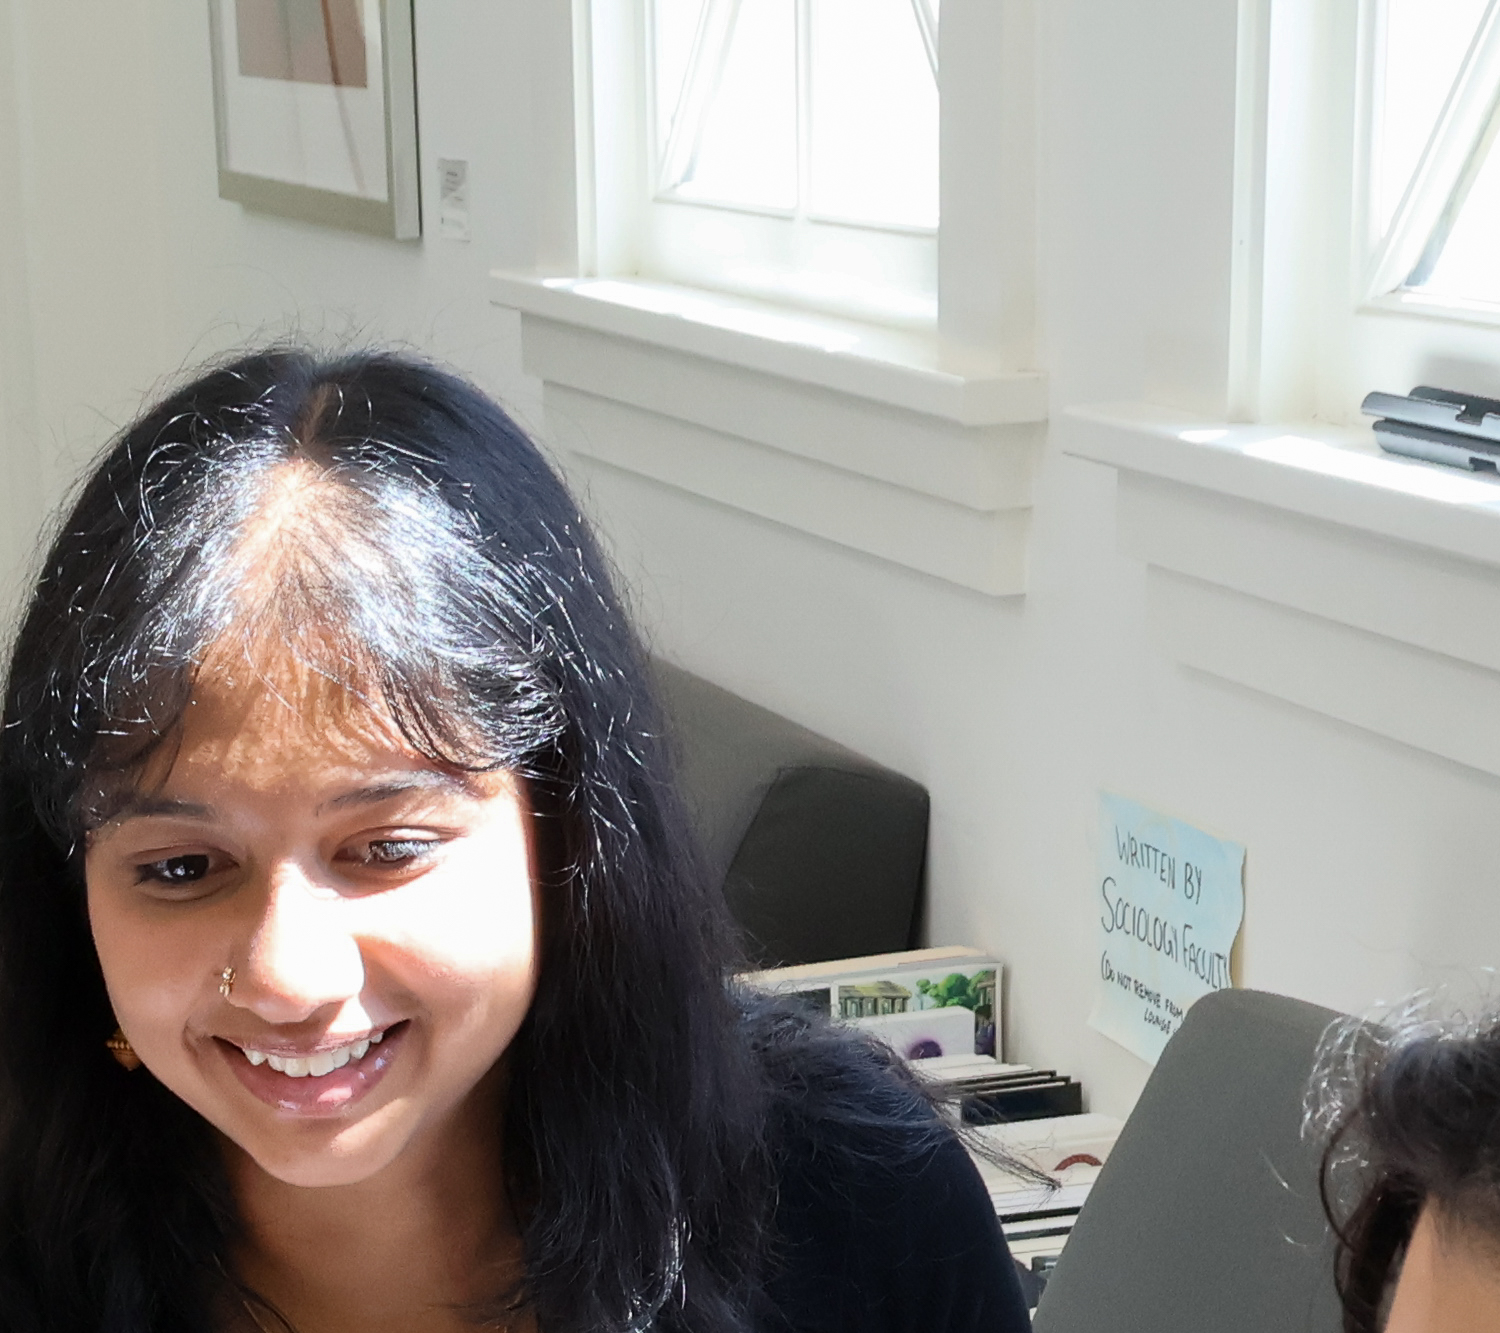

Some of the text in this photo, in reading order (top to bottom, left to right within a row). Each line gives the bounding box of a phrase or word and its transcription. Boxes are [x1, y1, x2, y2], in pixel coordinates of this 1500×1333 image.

[1116, 825, 1202, 905] WRITTEN BY
[1101, 876, 1231, 989] SOCIOLOGY FACULTY
[1117, 971, 1131, 991] NOT
[1133, 979, 1161, 1009] REMOVE
[1164, 999, 1184, 1022] FROM
